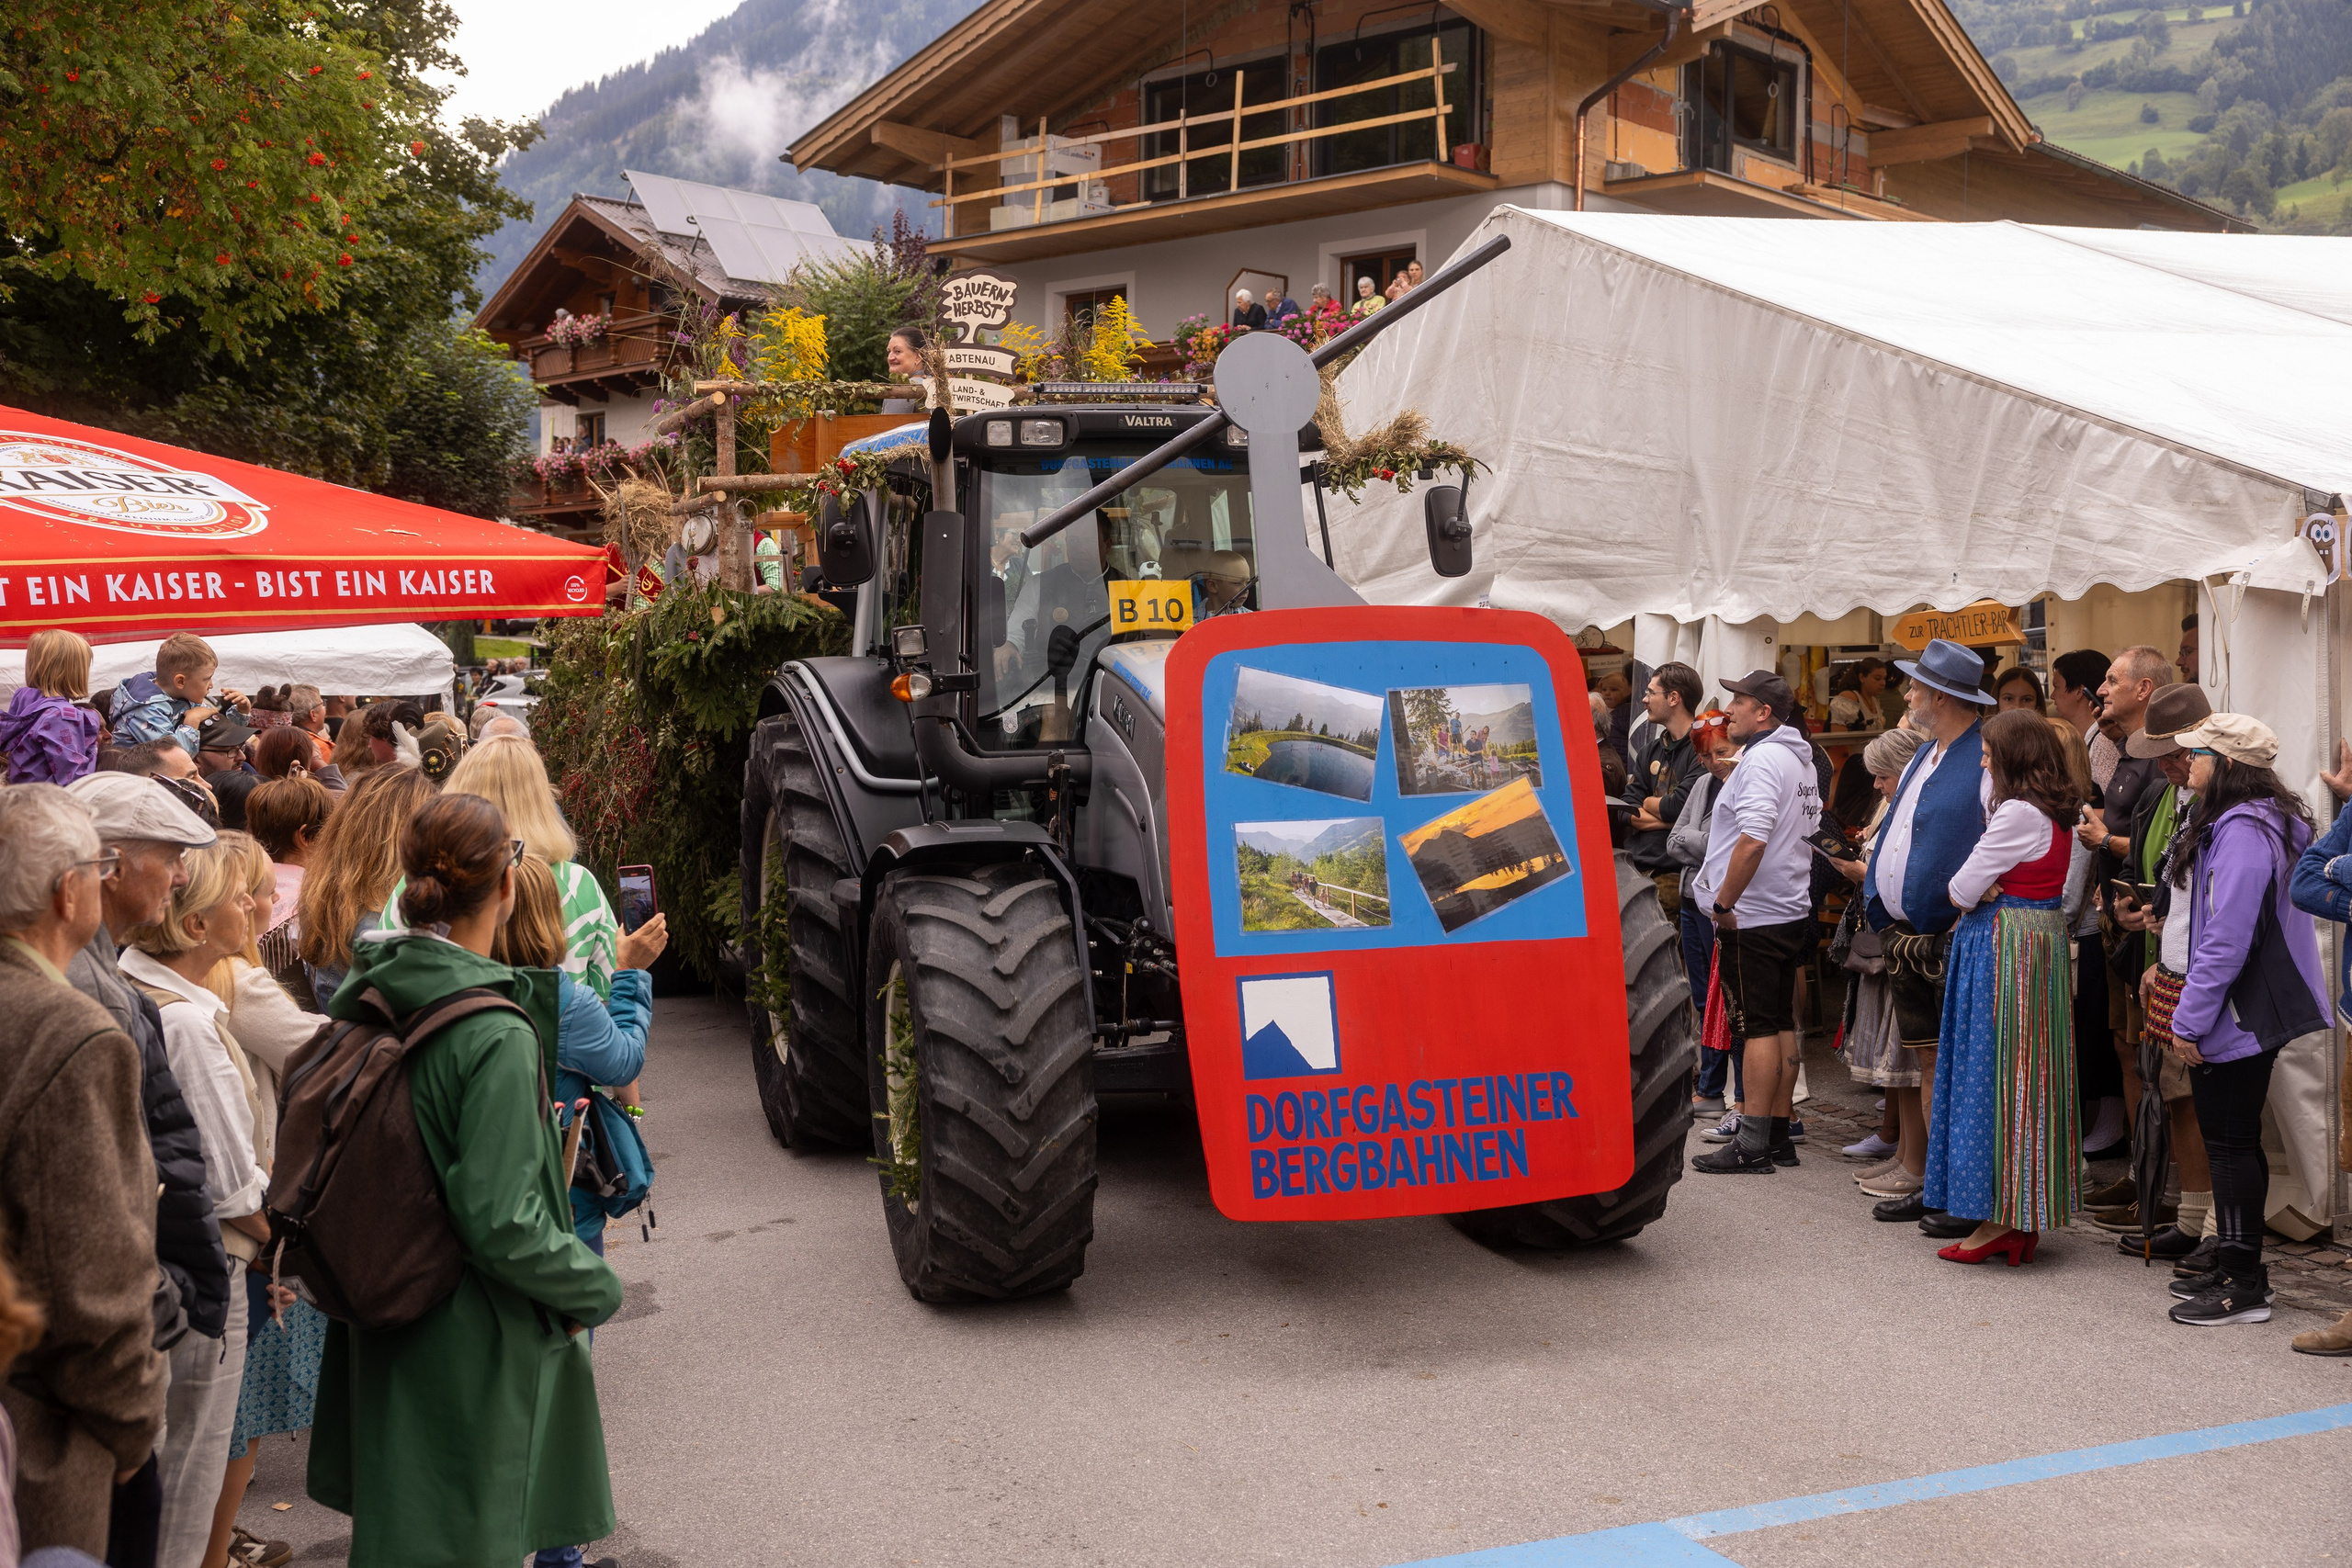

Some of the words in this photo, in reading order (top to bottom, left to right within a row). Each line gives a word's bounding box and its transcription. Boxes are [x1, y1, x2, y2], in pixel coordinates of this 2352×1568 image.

[953, 281, 1010, 302] BAUERN
[953, 299, 1003, 319] HERBST
[949, 354, 996, 366] ABTENAU
[953, 385, 978, 394] LAND-
[1125, 415, 1172, 427] VALTRA
[1218, 459, 1233, 469] AG
[92, 496, 193, 513] Bier
[27, 575, 91, 605] EIN
[106, 571, 226, 602] KAISER
[256, 570, 322, 598] BIST
[335, 570, 387, 596] EIN
[399, 569, 495, 595] KAISER
[1118, 599, 1138, 623] B
[1147, 598, 1183, 623] 10
[1908, 626, 1924, 638] ZUR
[1246, 1071, 1579, 1144] DORFGASTEINER
[1250, 1128, 1530, 1200] BERGBAHNEN
